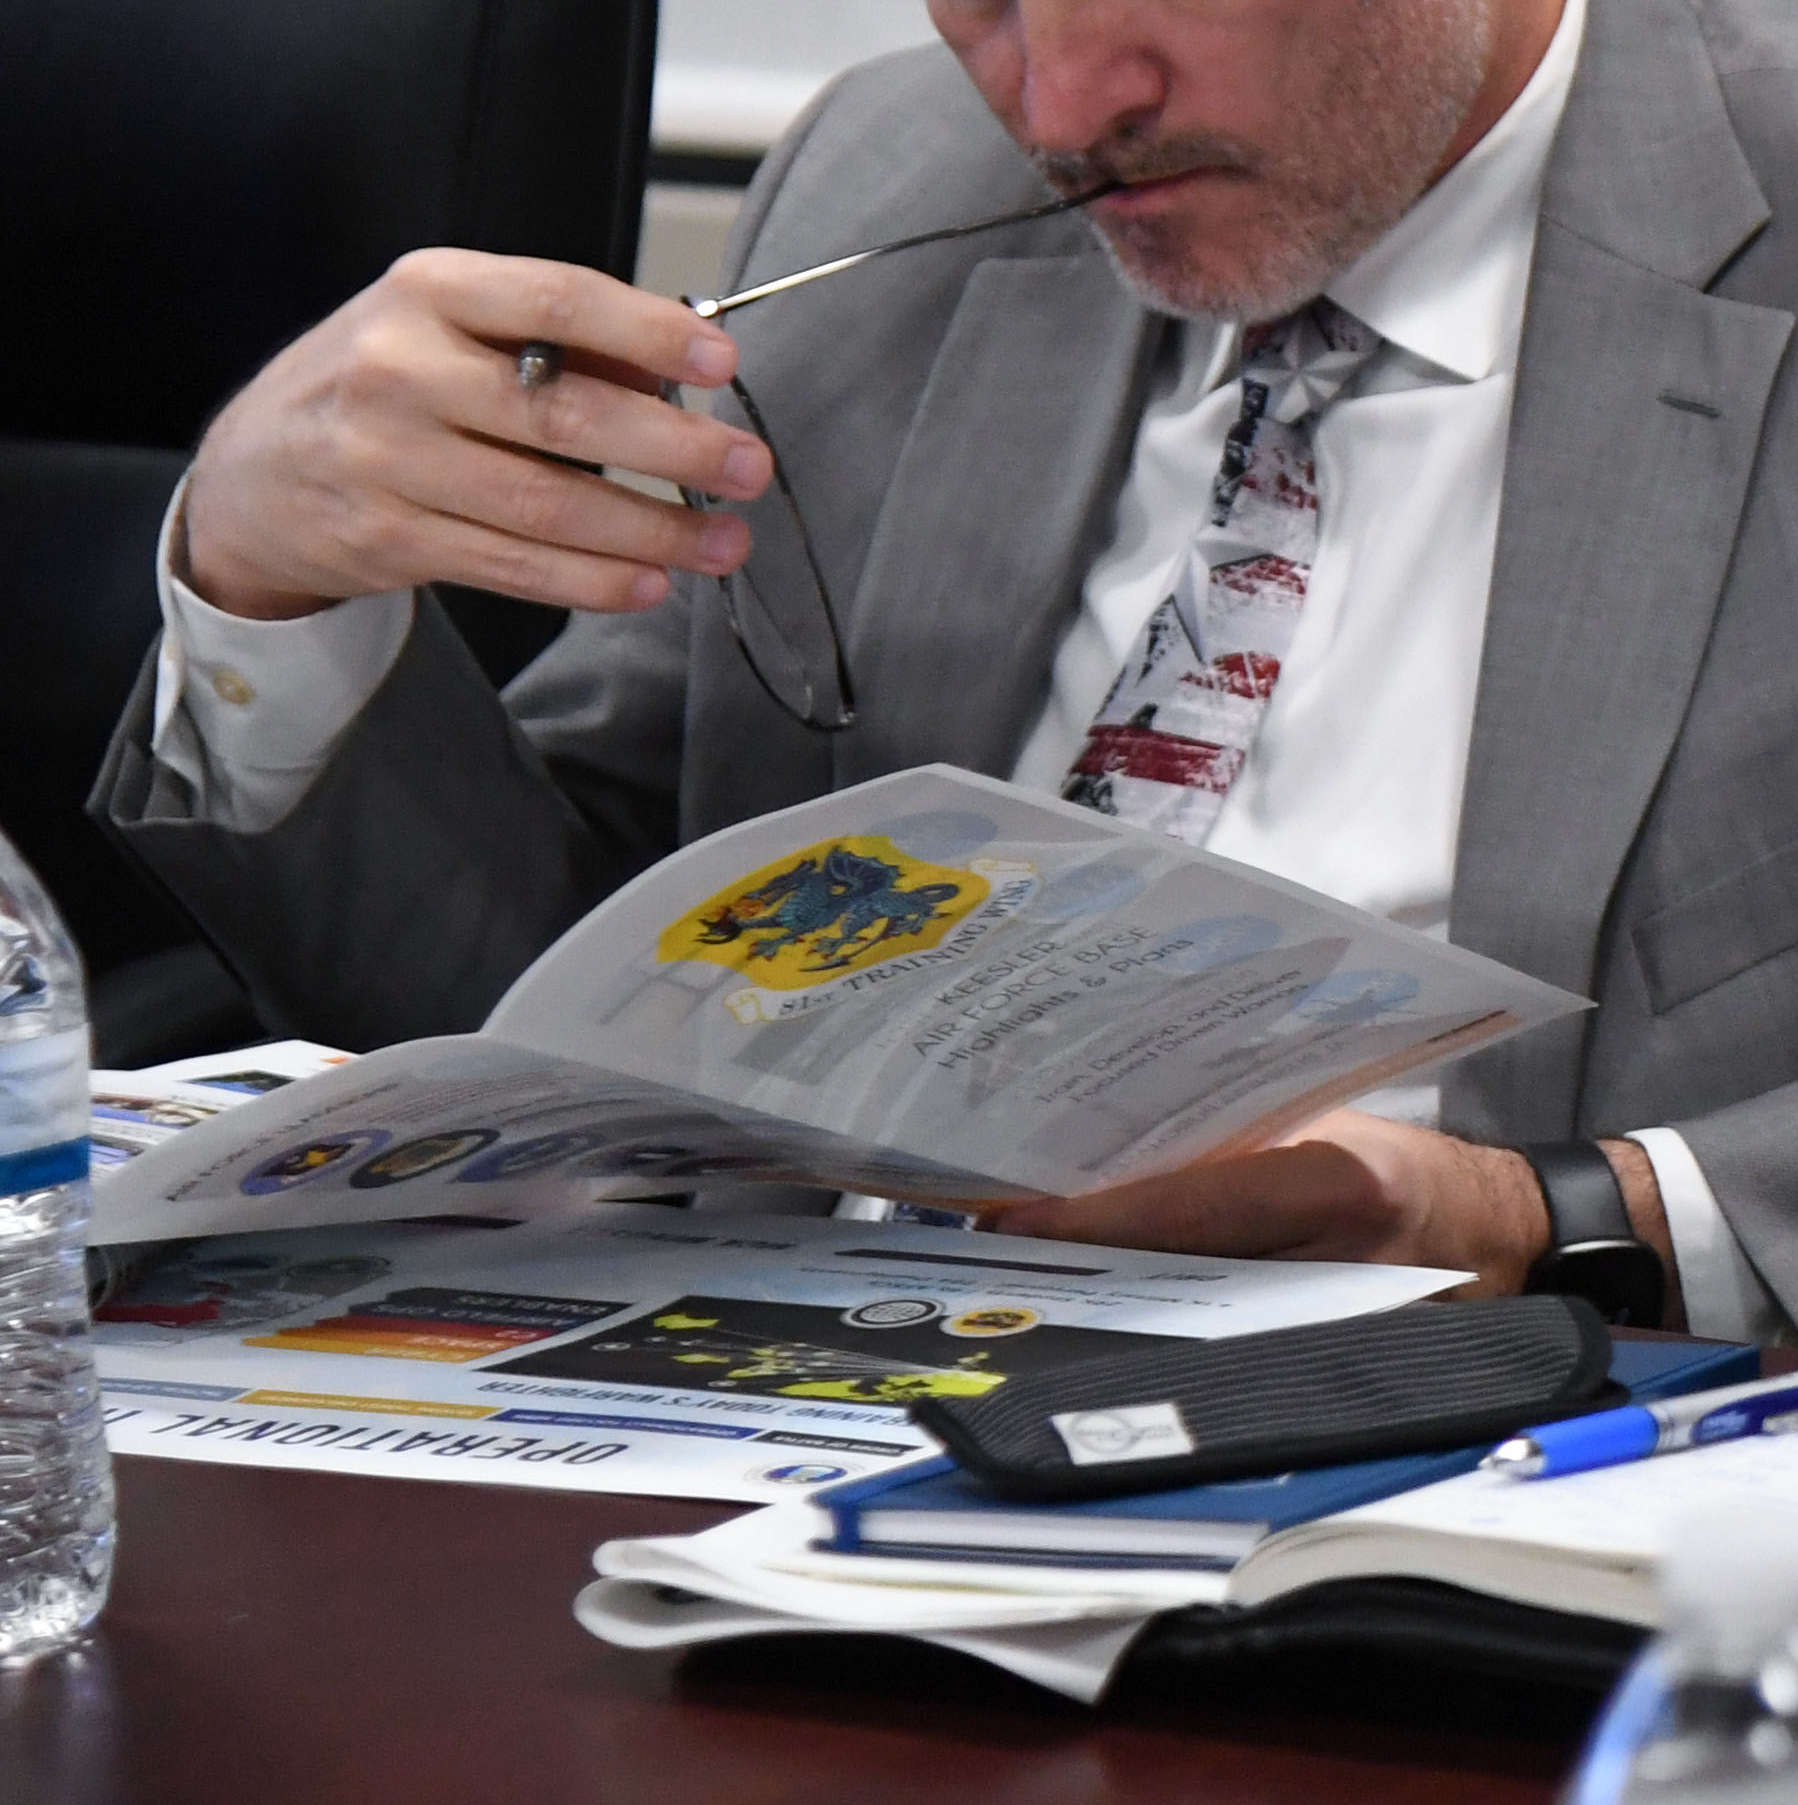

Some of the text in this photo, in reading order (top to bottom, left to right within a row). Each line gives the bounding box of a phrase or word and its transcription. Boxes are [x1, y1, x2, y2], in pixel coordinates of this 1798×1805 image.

[842, 923, 987, 992] TRAINING
[978, 879, 1033, 920] WING
[913, 926, 1157, 1057] AIR FORCE BASE
[935, 941, 1062, 1005] KEESLER
[938, 990, 1079, 1069] Highlights
[1109, 938, 1194, 974] Plans
[477, 1380, 660, 1404] WARFIGHTER
[661, 1395, 784, 1417] TODAY'S
[149, 1412, 630, 1466] OPERATIONAL
